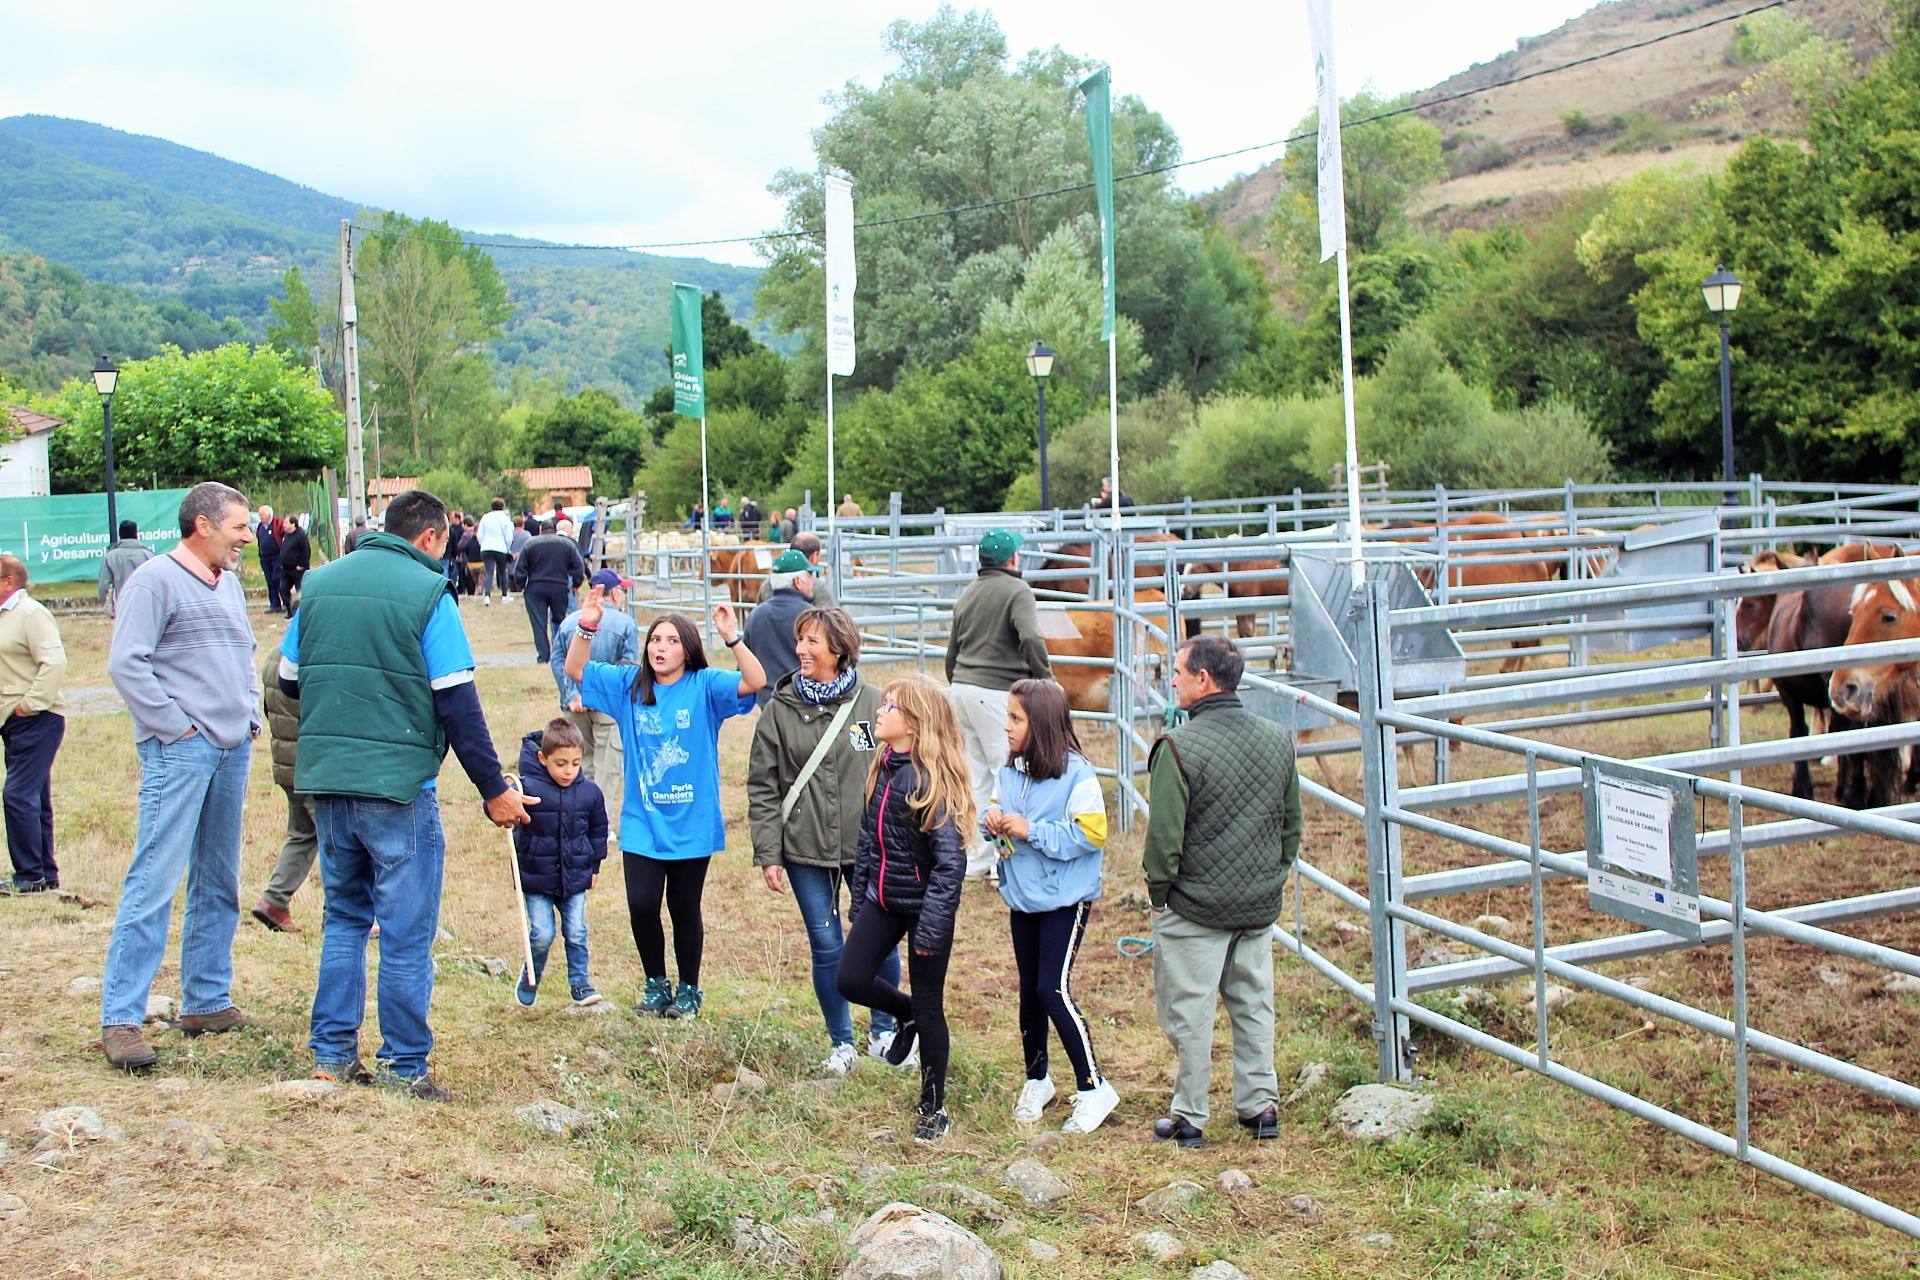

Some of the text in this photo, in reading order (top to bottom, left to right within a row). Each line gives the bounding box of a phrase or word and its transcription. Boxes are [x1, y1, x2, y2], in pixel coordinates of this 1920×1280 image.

[40, 527, 181, 547] Agricultura nadería
[41, 550, 49, 563] y
[1616, 805, 1628, 813] FERIA
[1636, 811, 1655, 820] GANADO
